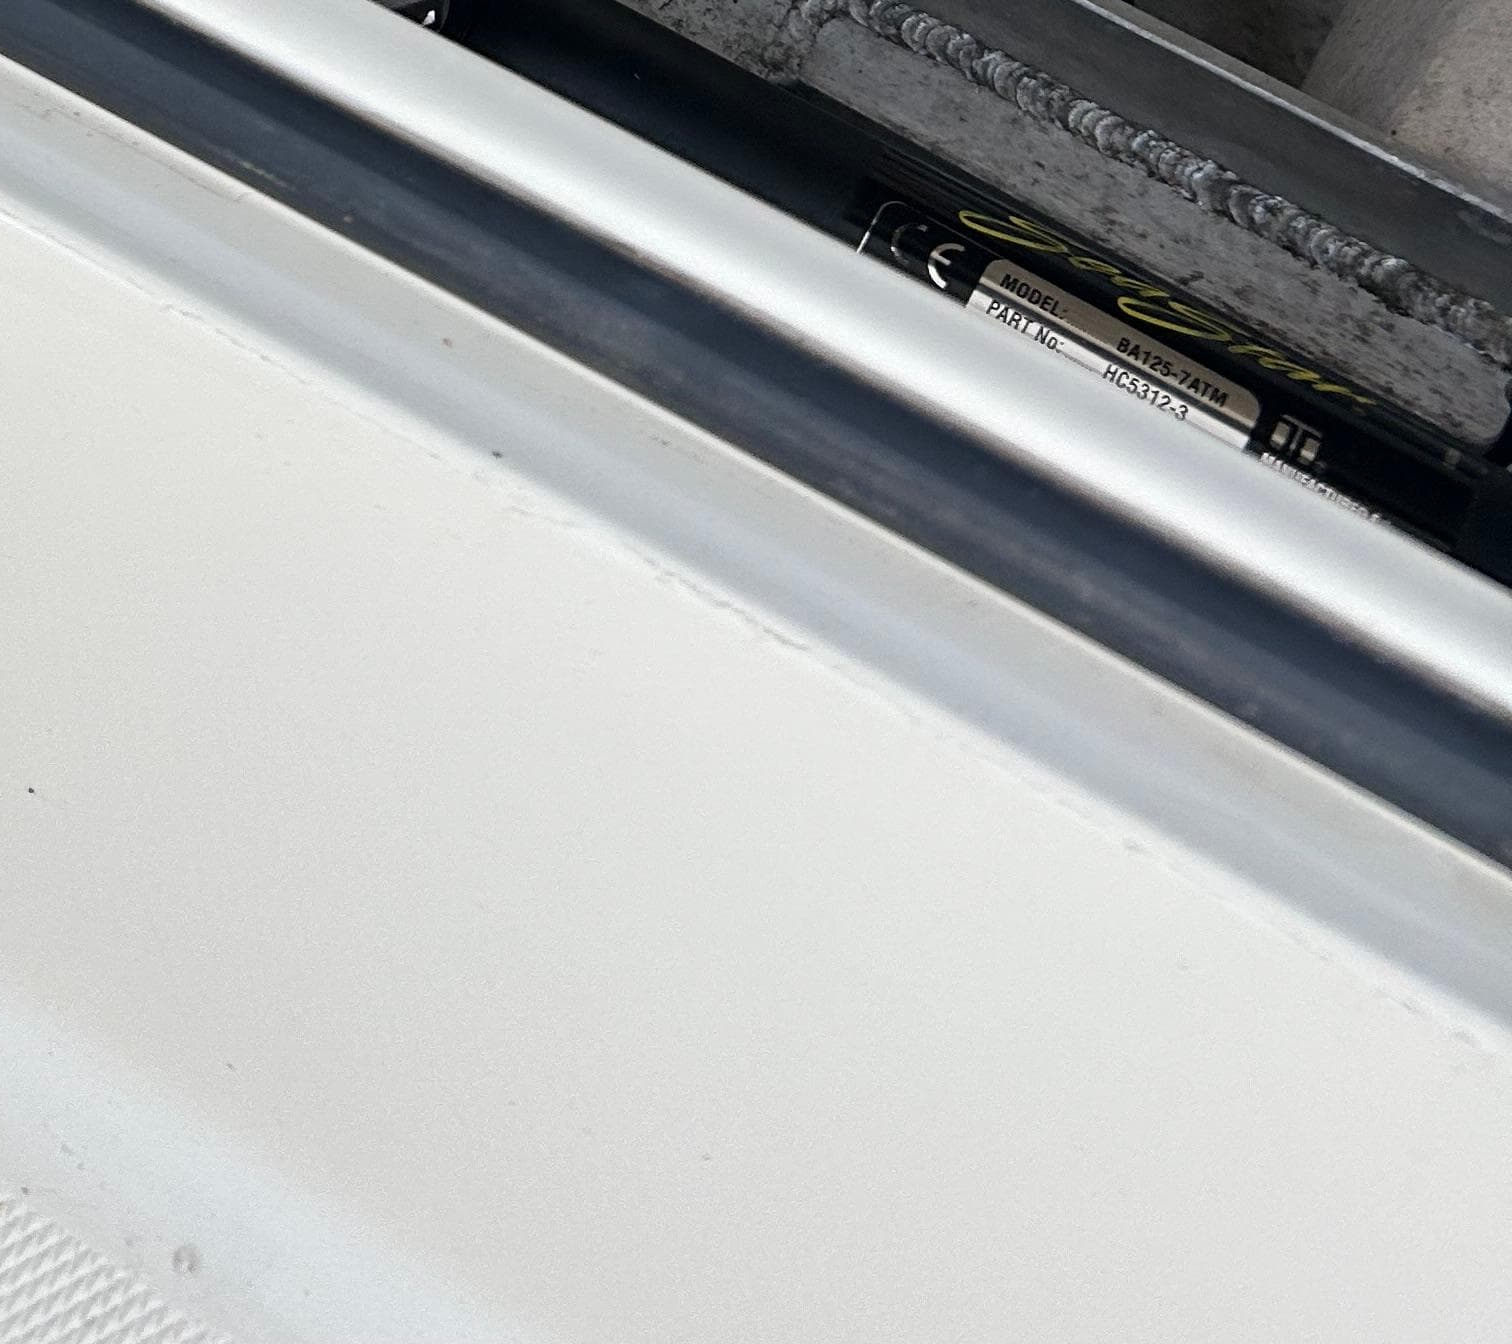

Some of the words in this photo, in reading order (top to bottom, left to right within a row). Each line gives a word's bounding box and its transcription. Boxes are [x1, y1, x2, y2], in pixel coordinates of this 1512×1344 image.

[985, 298, 1033, 335] PART
[1101, 363, 1190, 422] HC5312-3
[1116, 335, 1231, 409] BA125-7ATM
